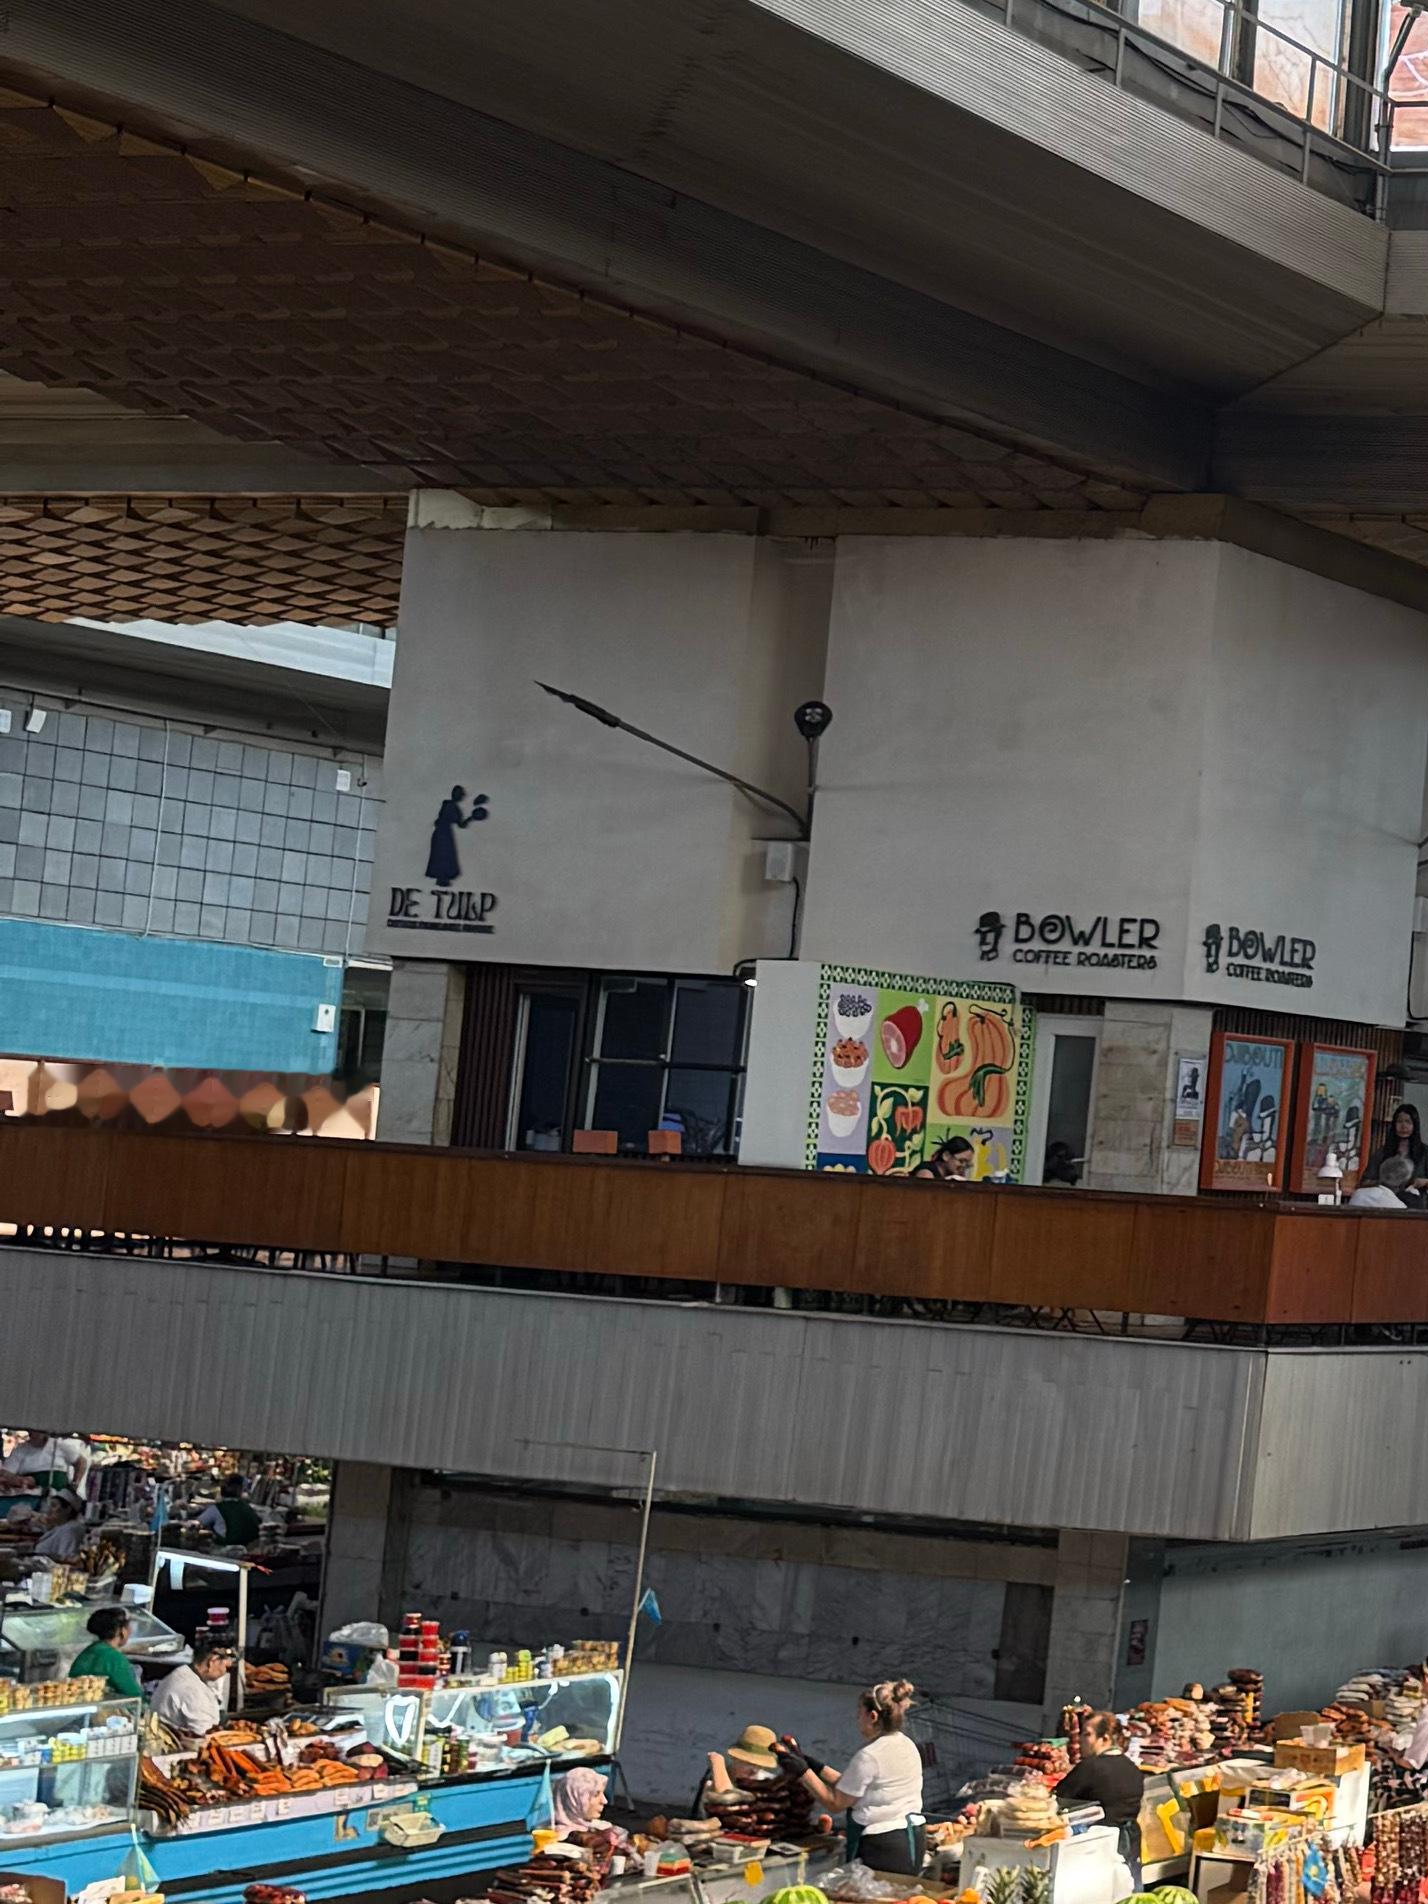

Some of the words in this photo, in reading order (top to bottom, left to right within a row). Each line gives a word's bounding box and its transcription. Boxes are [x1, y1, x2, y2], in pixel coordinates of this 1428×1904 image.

[388, 887, 422, 918] DE
[430, 889, 497, 922] TULP
[1013, 912, 1160, 950] BOWLER
[1227, 926, 1316, 970] BOWLER
[1012, 948, 1072, 967] COFFEE
[1076, 951, 1158, 970] ROASTERS
